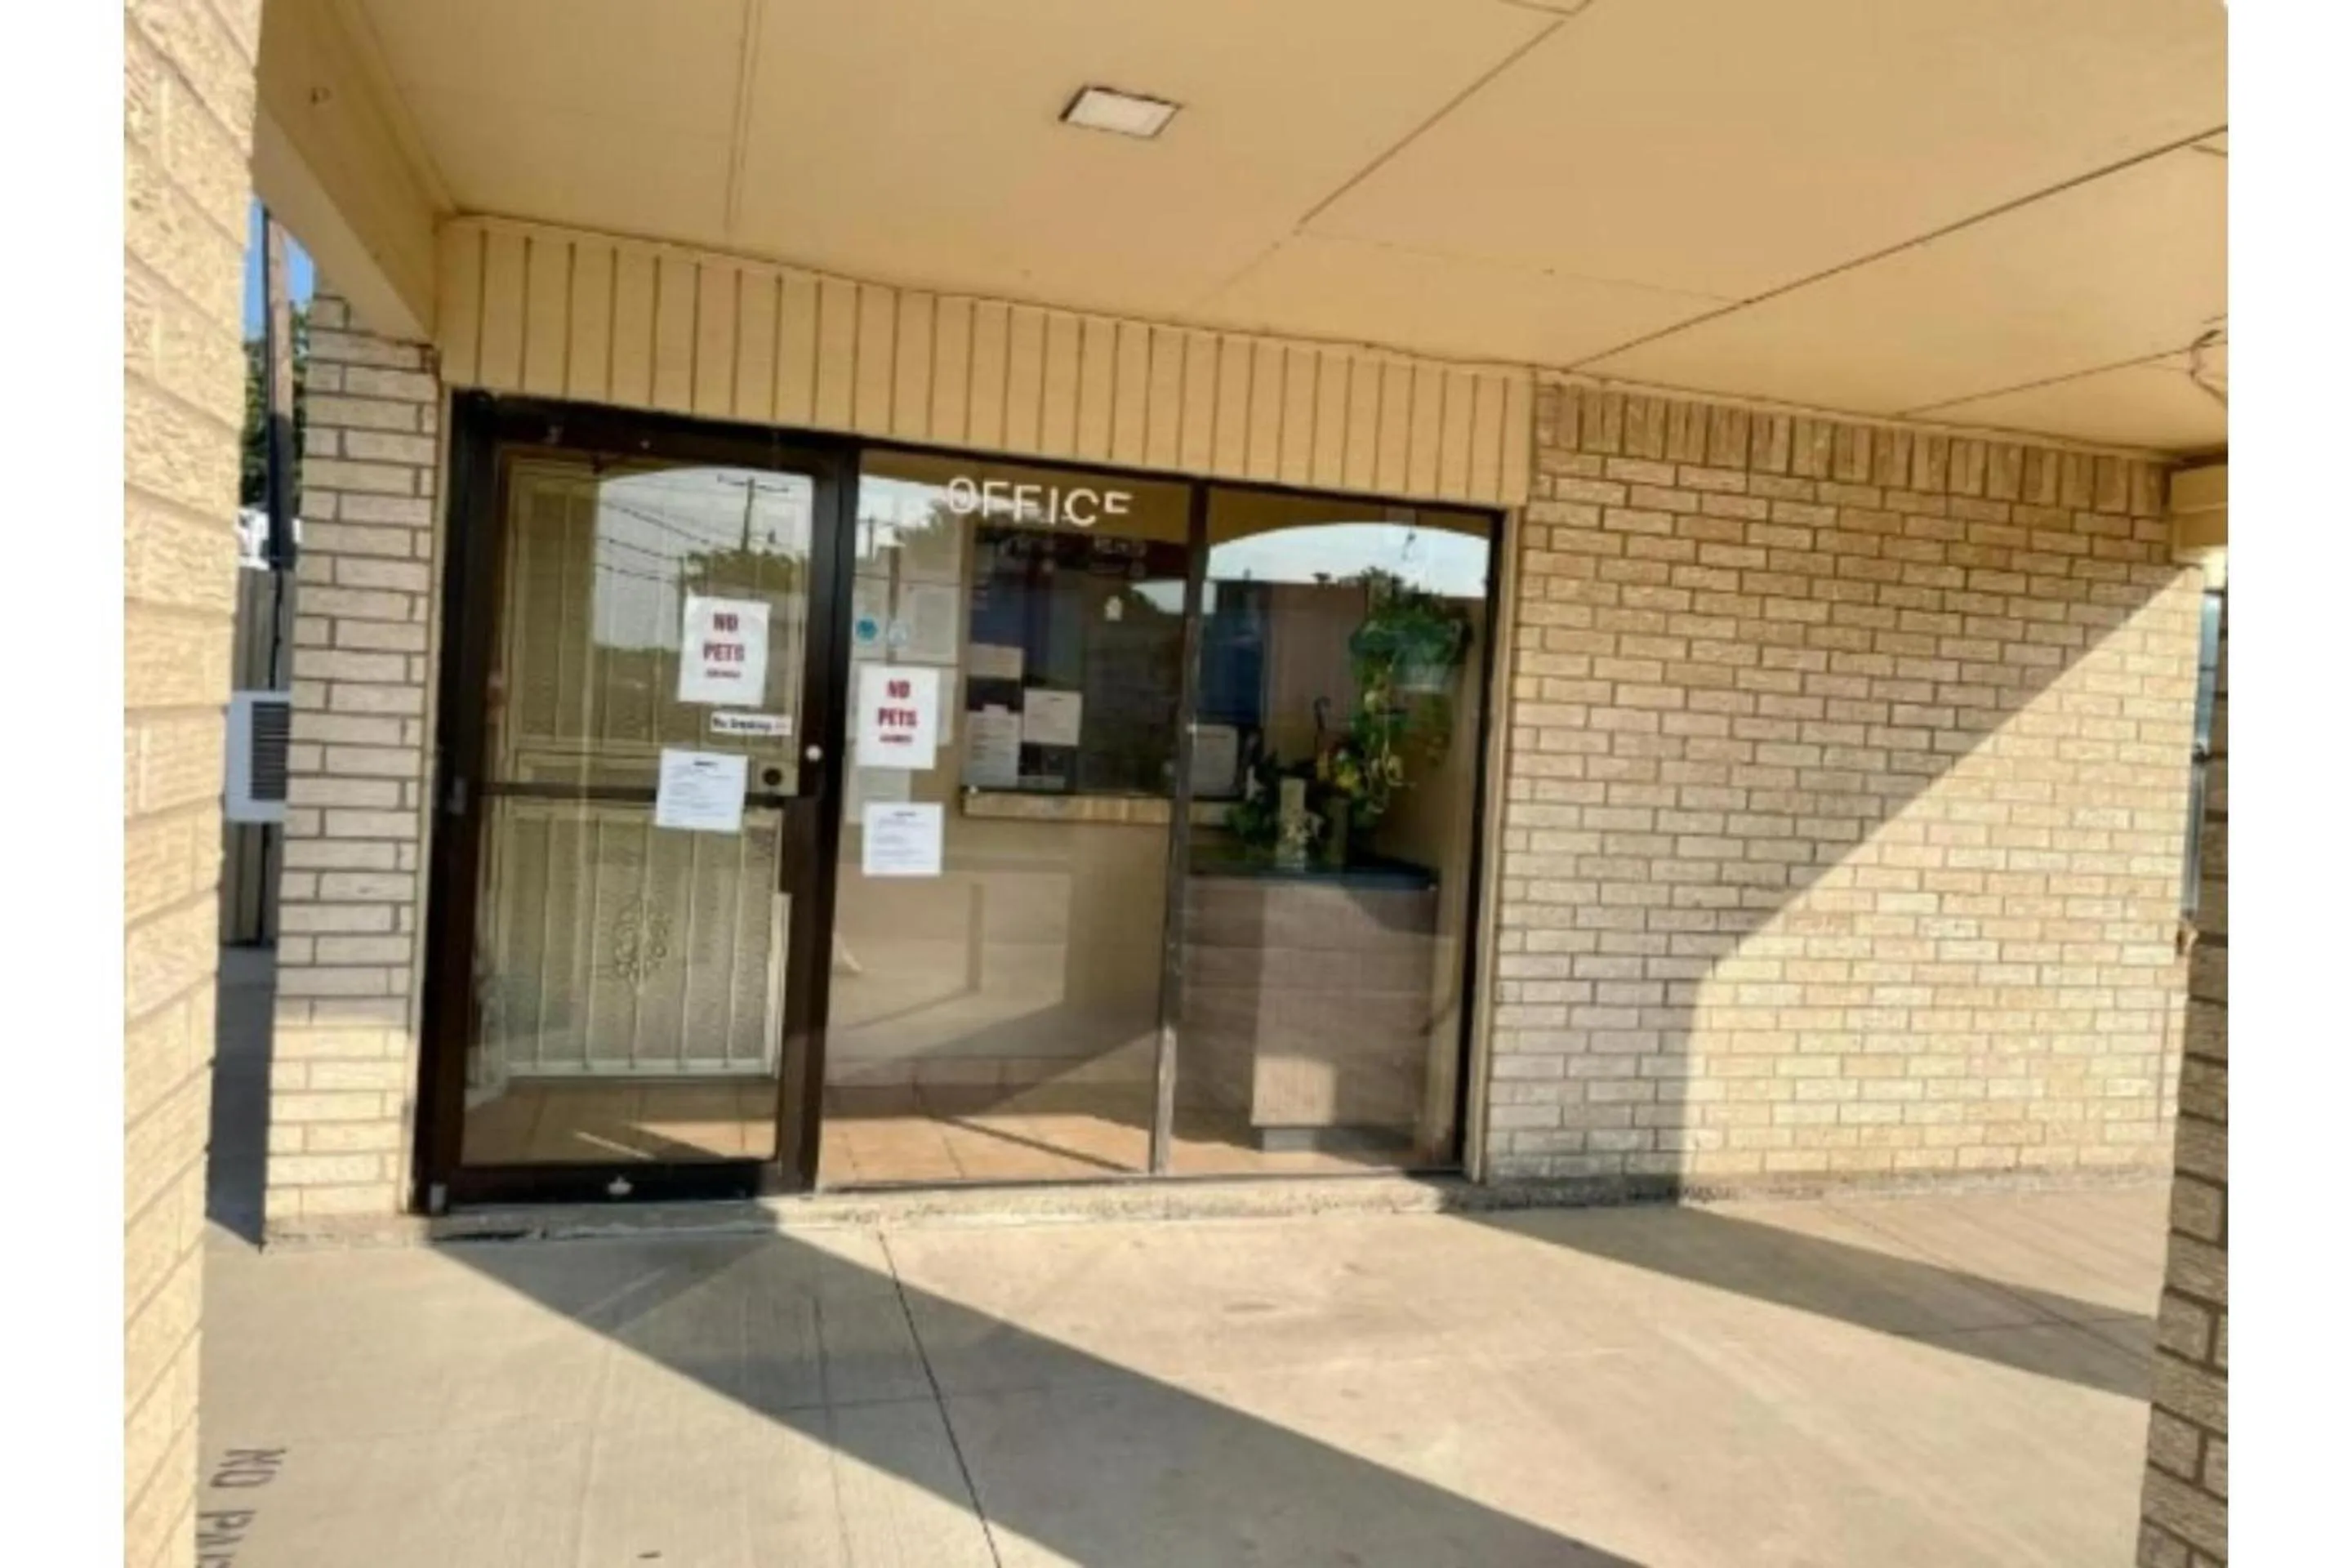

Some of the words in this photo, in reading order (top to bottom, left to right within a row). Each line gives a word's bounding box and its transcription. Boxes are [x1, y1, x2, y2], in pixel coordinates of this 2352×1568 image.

[713, 612, 739, 633] NO
[703, 642, 745, 662] PETS
[886, 679, 911, 699] NO
[878, 707, 917, 728] PETS
